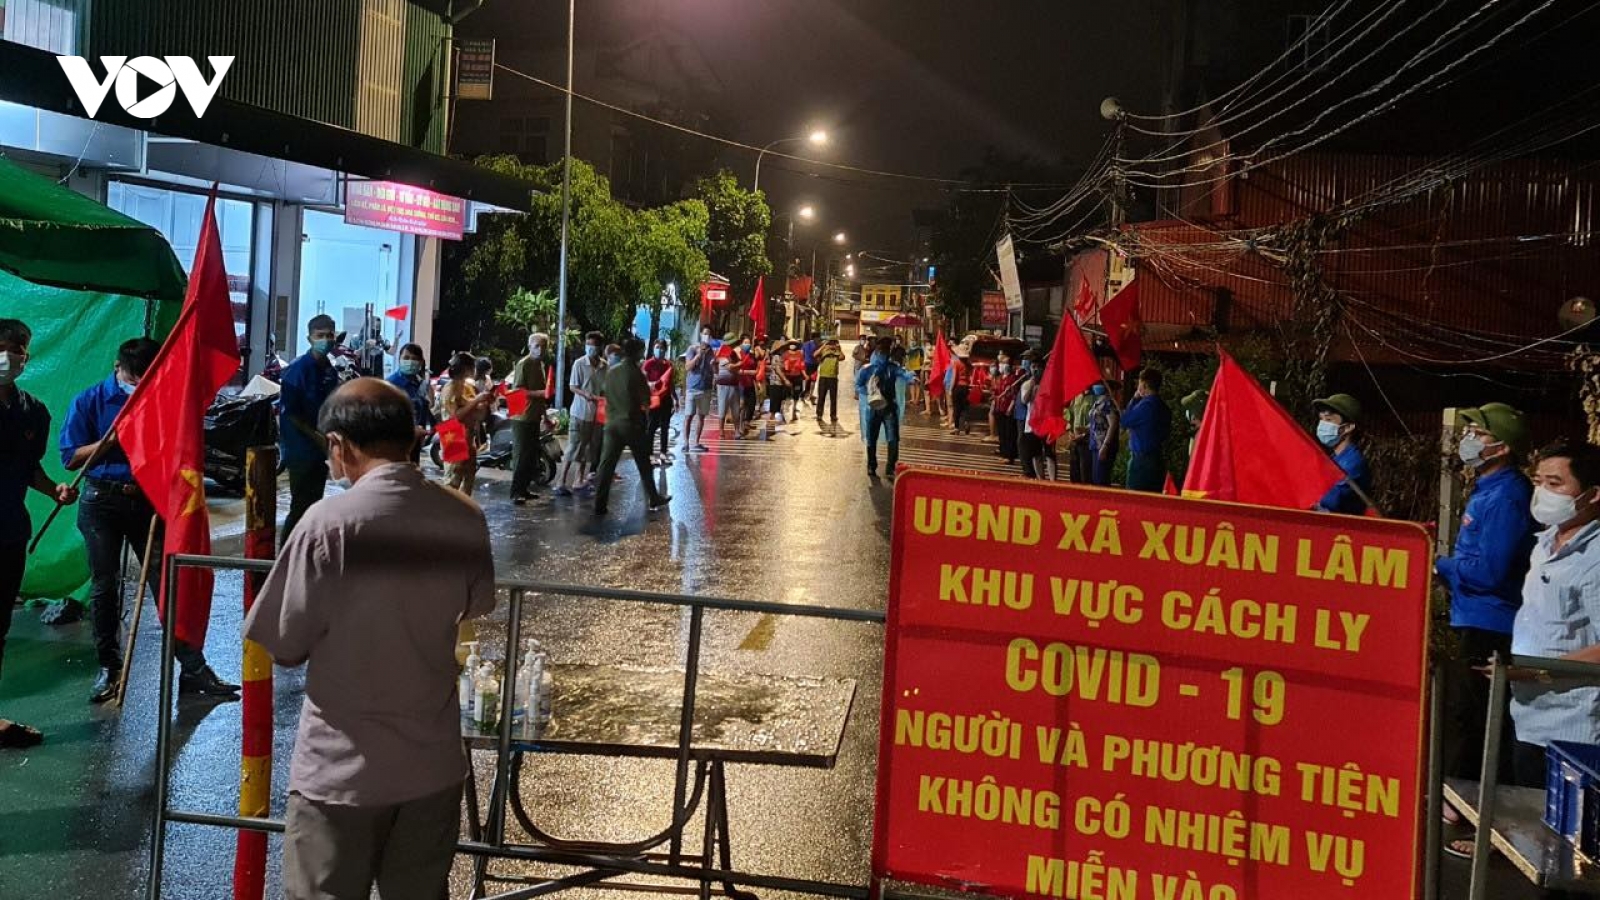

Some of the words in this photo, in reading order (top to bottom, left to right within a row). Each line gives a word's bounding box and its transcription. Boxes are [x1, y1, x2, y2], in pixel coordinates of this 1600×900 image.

[914, 499, 1041, 545] UBND
[1059, 509, 1122, 555] XÃ
[1141, 521, 1278, 573] XUÂN
[1297, 534, 1409, 588] LÂM
[939, 565, 1034, 610] KHU
[1051, 577, 1144, 628] VỰC
[1161, 588, 1296, 643] CÁCH
[1314, 609, 1370, 652] LY
[1005, 638, 1161, 707] COVID
[1179, 685, 1199, 697] -
[1221, 667, 1286, 725] 19
[895, 709, 1022, 759] NGƯỜI
[1036, 725, 1088, 767] VÀ
[1103, 735, 1281, 797] PHƯƠNG
[1296, 761, 1400, 818] TIỆN
[918, 775, 1060, 830] KHÔNG
[1074, 791, 1131, 839] CÓ
[1144, 808, 1290, 867] NHIỆM
[1306, 831, 1365, 886] VỤ
[1025, 849, 1138, 900] MIỄN
